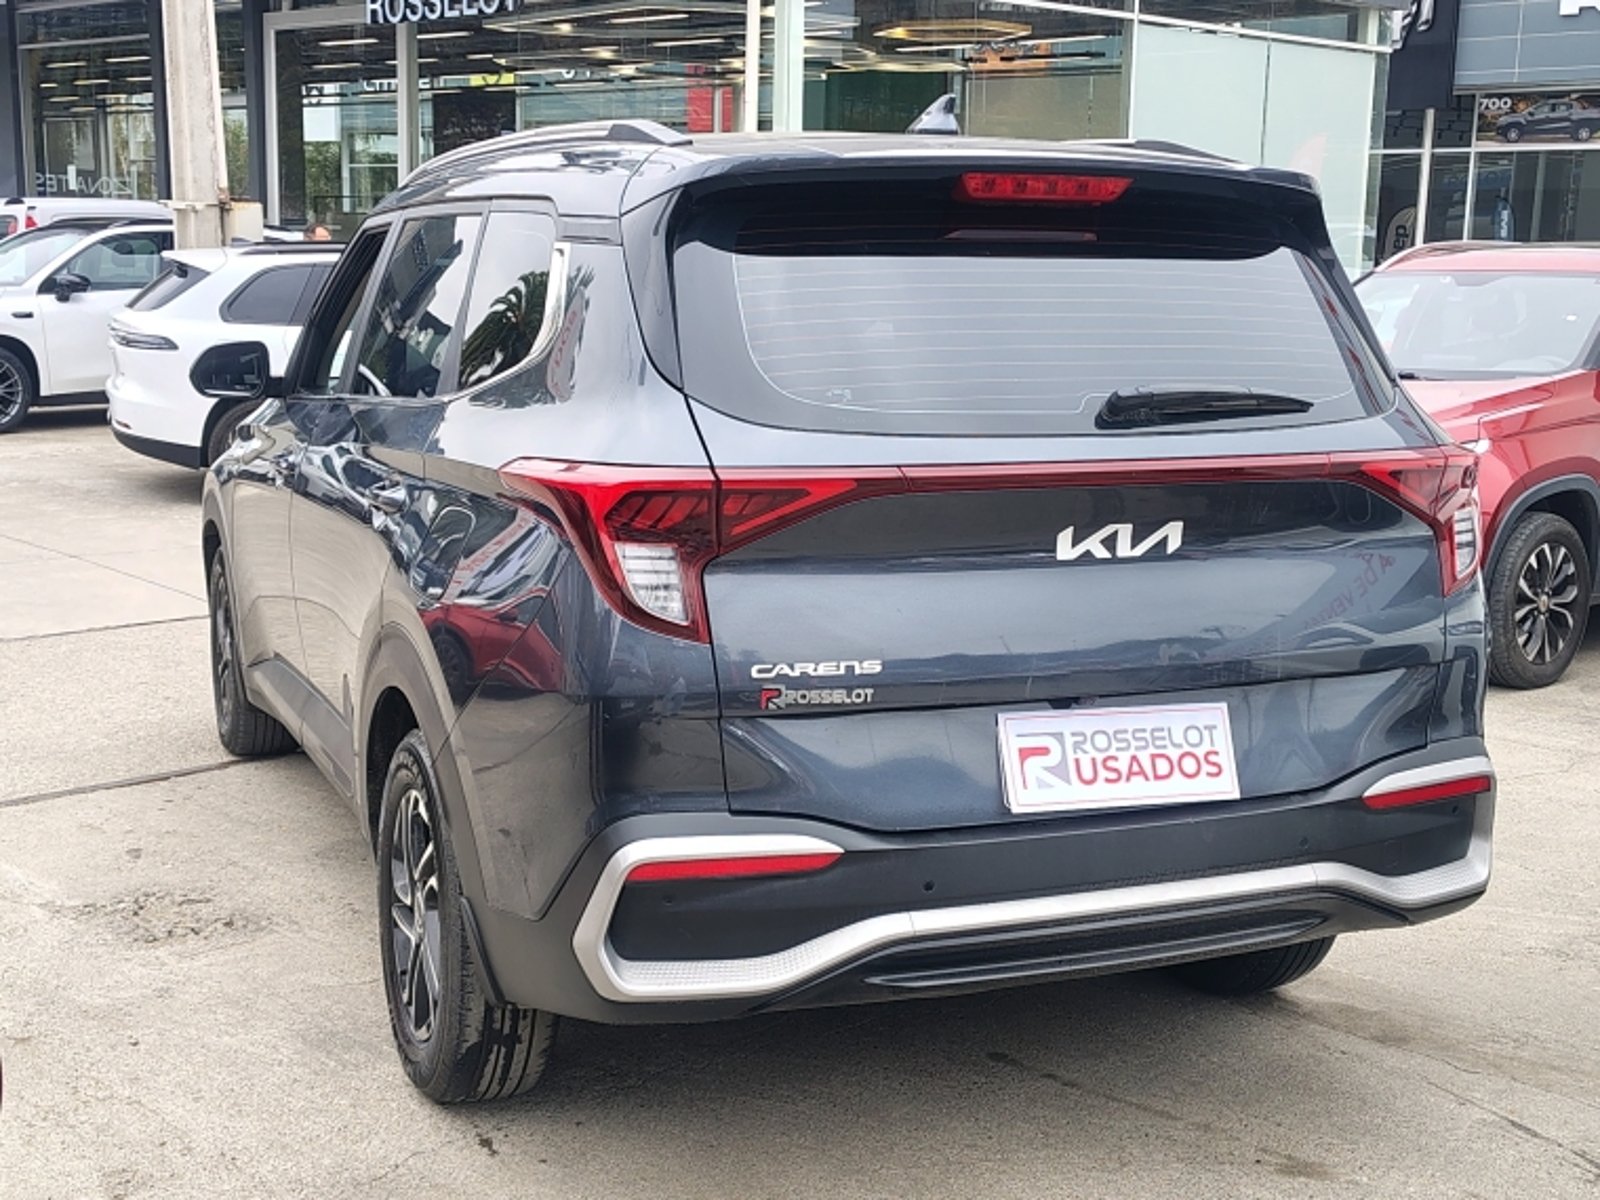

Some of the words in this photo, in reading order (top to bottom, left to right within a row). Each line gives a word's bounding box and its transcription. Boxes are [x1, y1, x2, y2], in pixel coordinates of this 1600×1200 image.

[1479, 97, 1512, 111] 700
[1056, 520, 1184, 560] KIA
[750, 659, 883, 679] CARENS
[785, 688, 874, 705] ROSSELOT
[1070, 724, 1218, 755] ROSSELOT
[1074, 750, 1223, 786] USADOS
